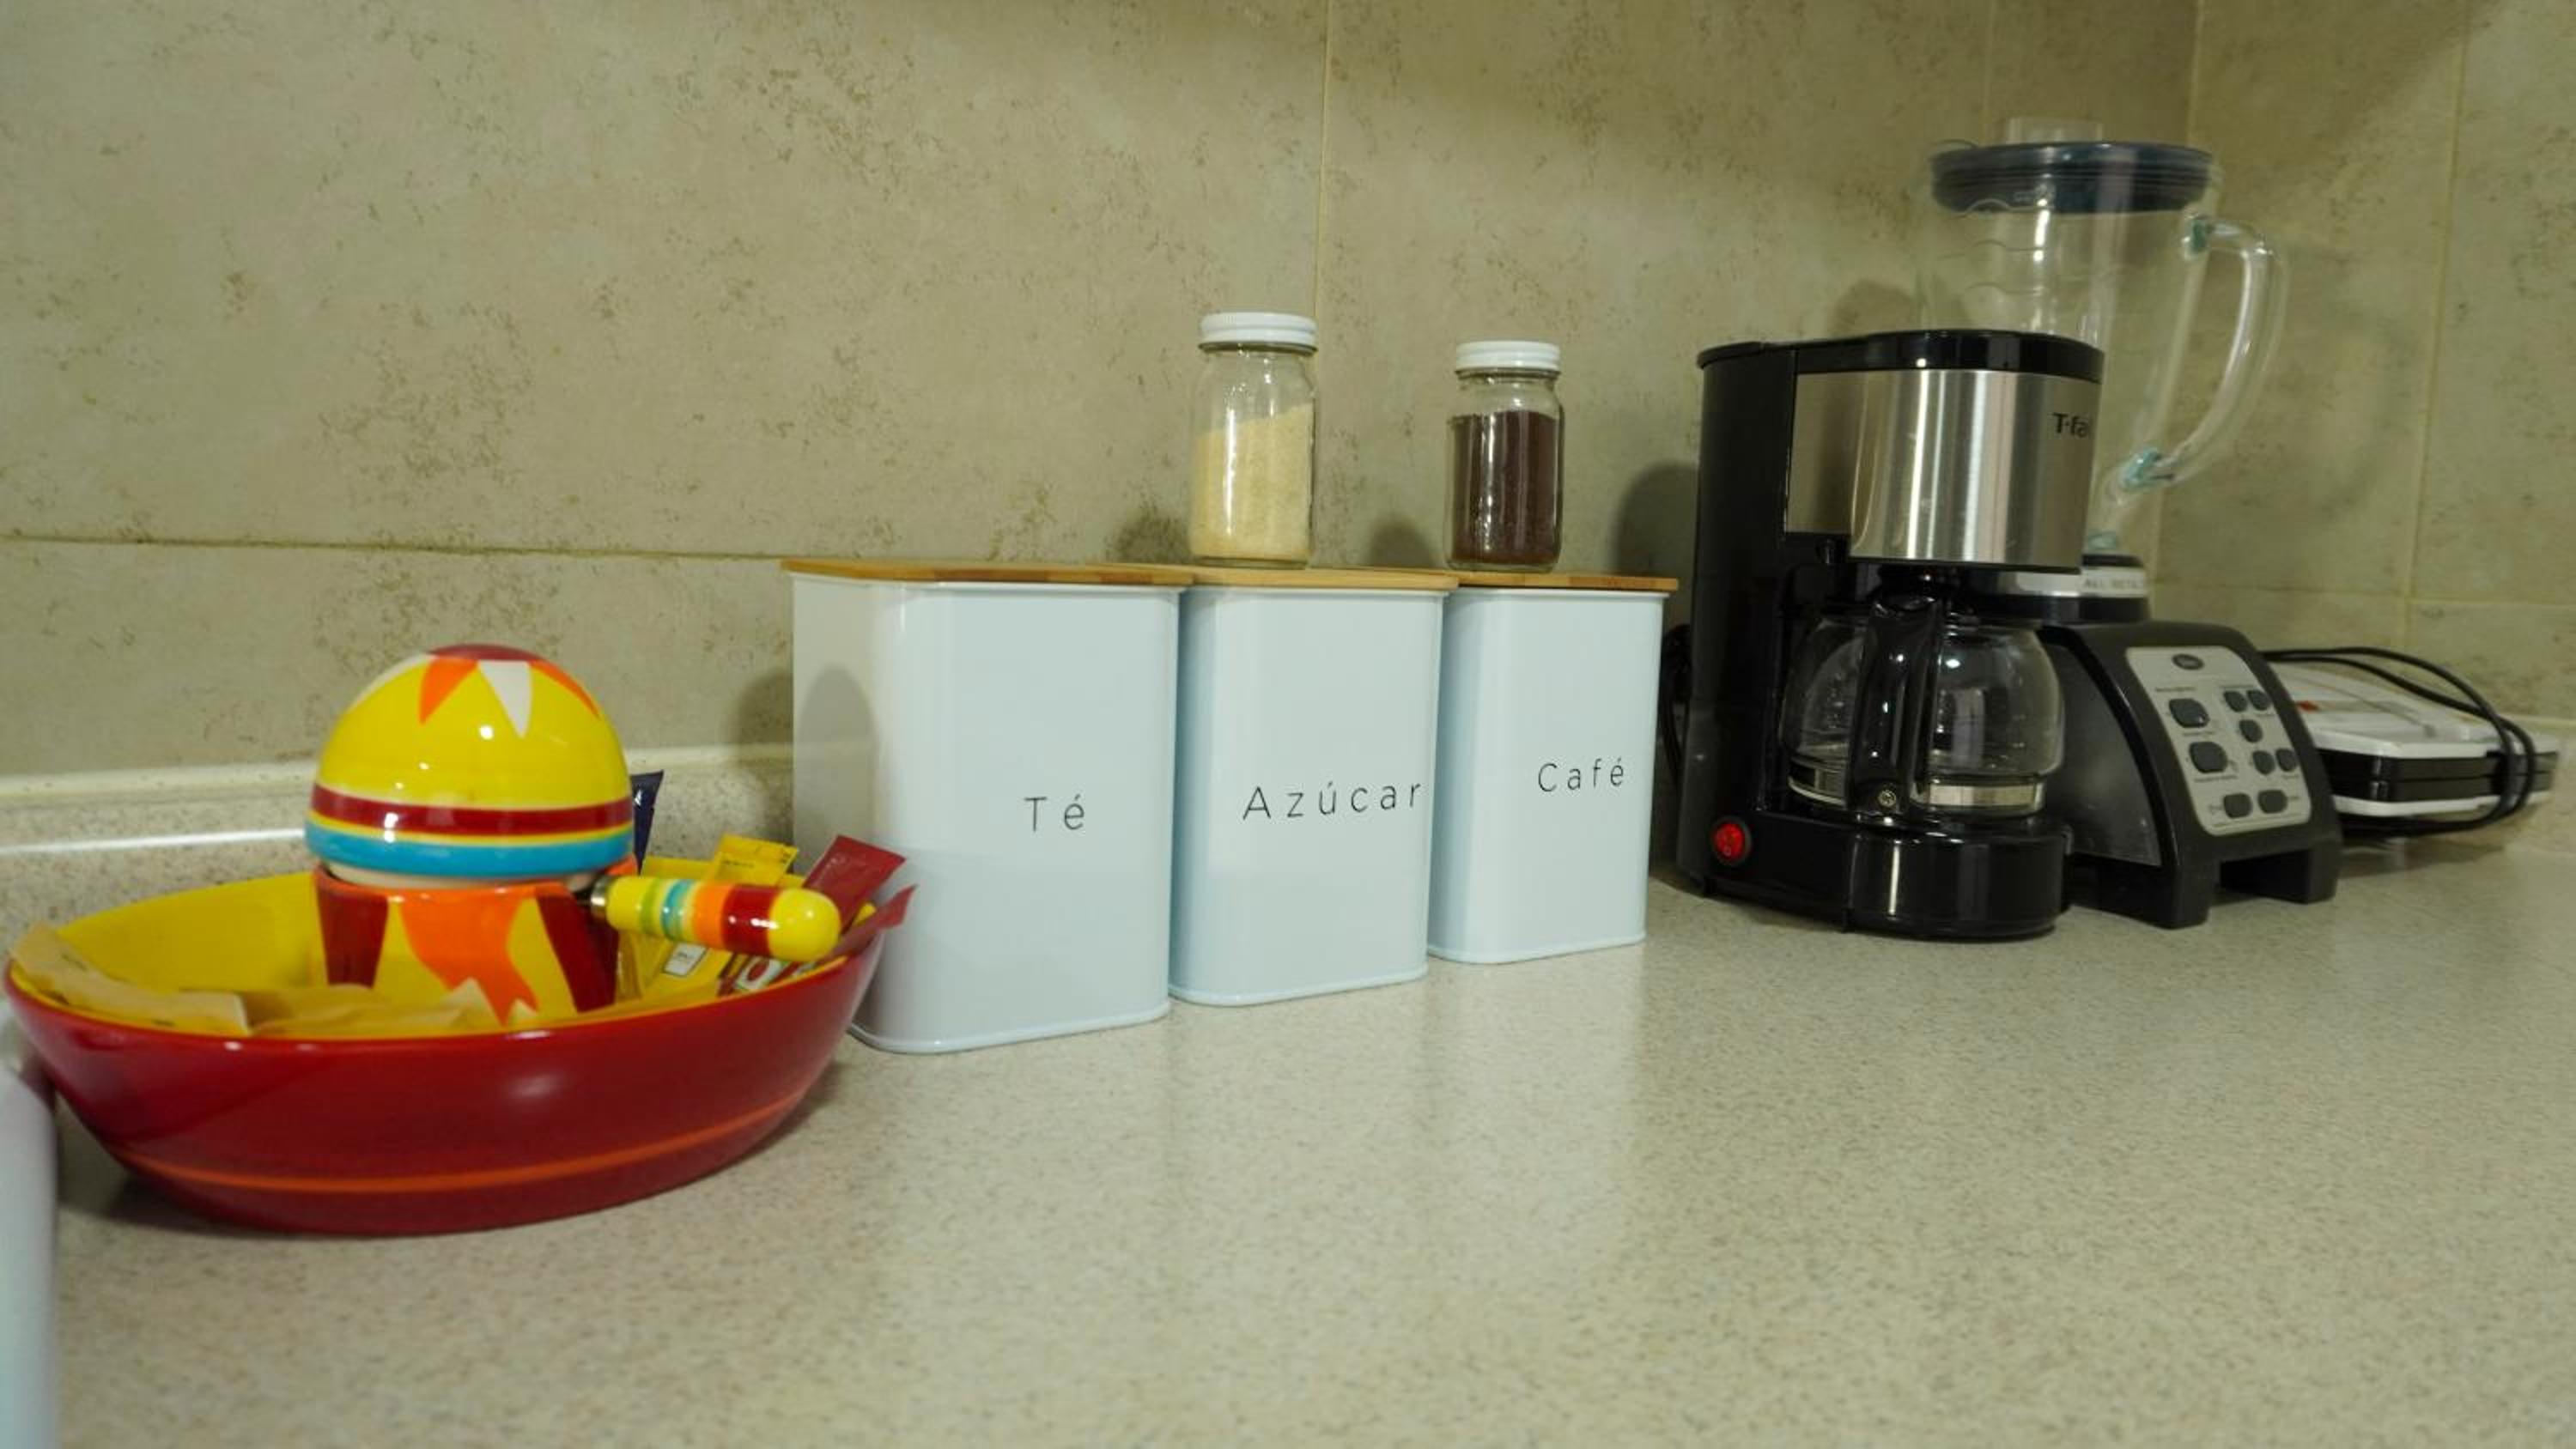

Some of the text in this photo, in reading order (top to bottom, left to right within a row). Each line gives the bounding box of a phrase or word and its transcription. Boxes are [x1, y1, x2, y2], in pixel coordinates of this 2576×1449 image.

[1538, 757, 1624, 792] Café
[1024, 793, 1084, 832] Té
[1242, 781, 1421, 820] Azúcar
